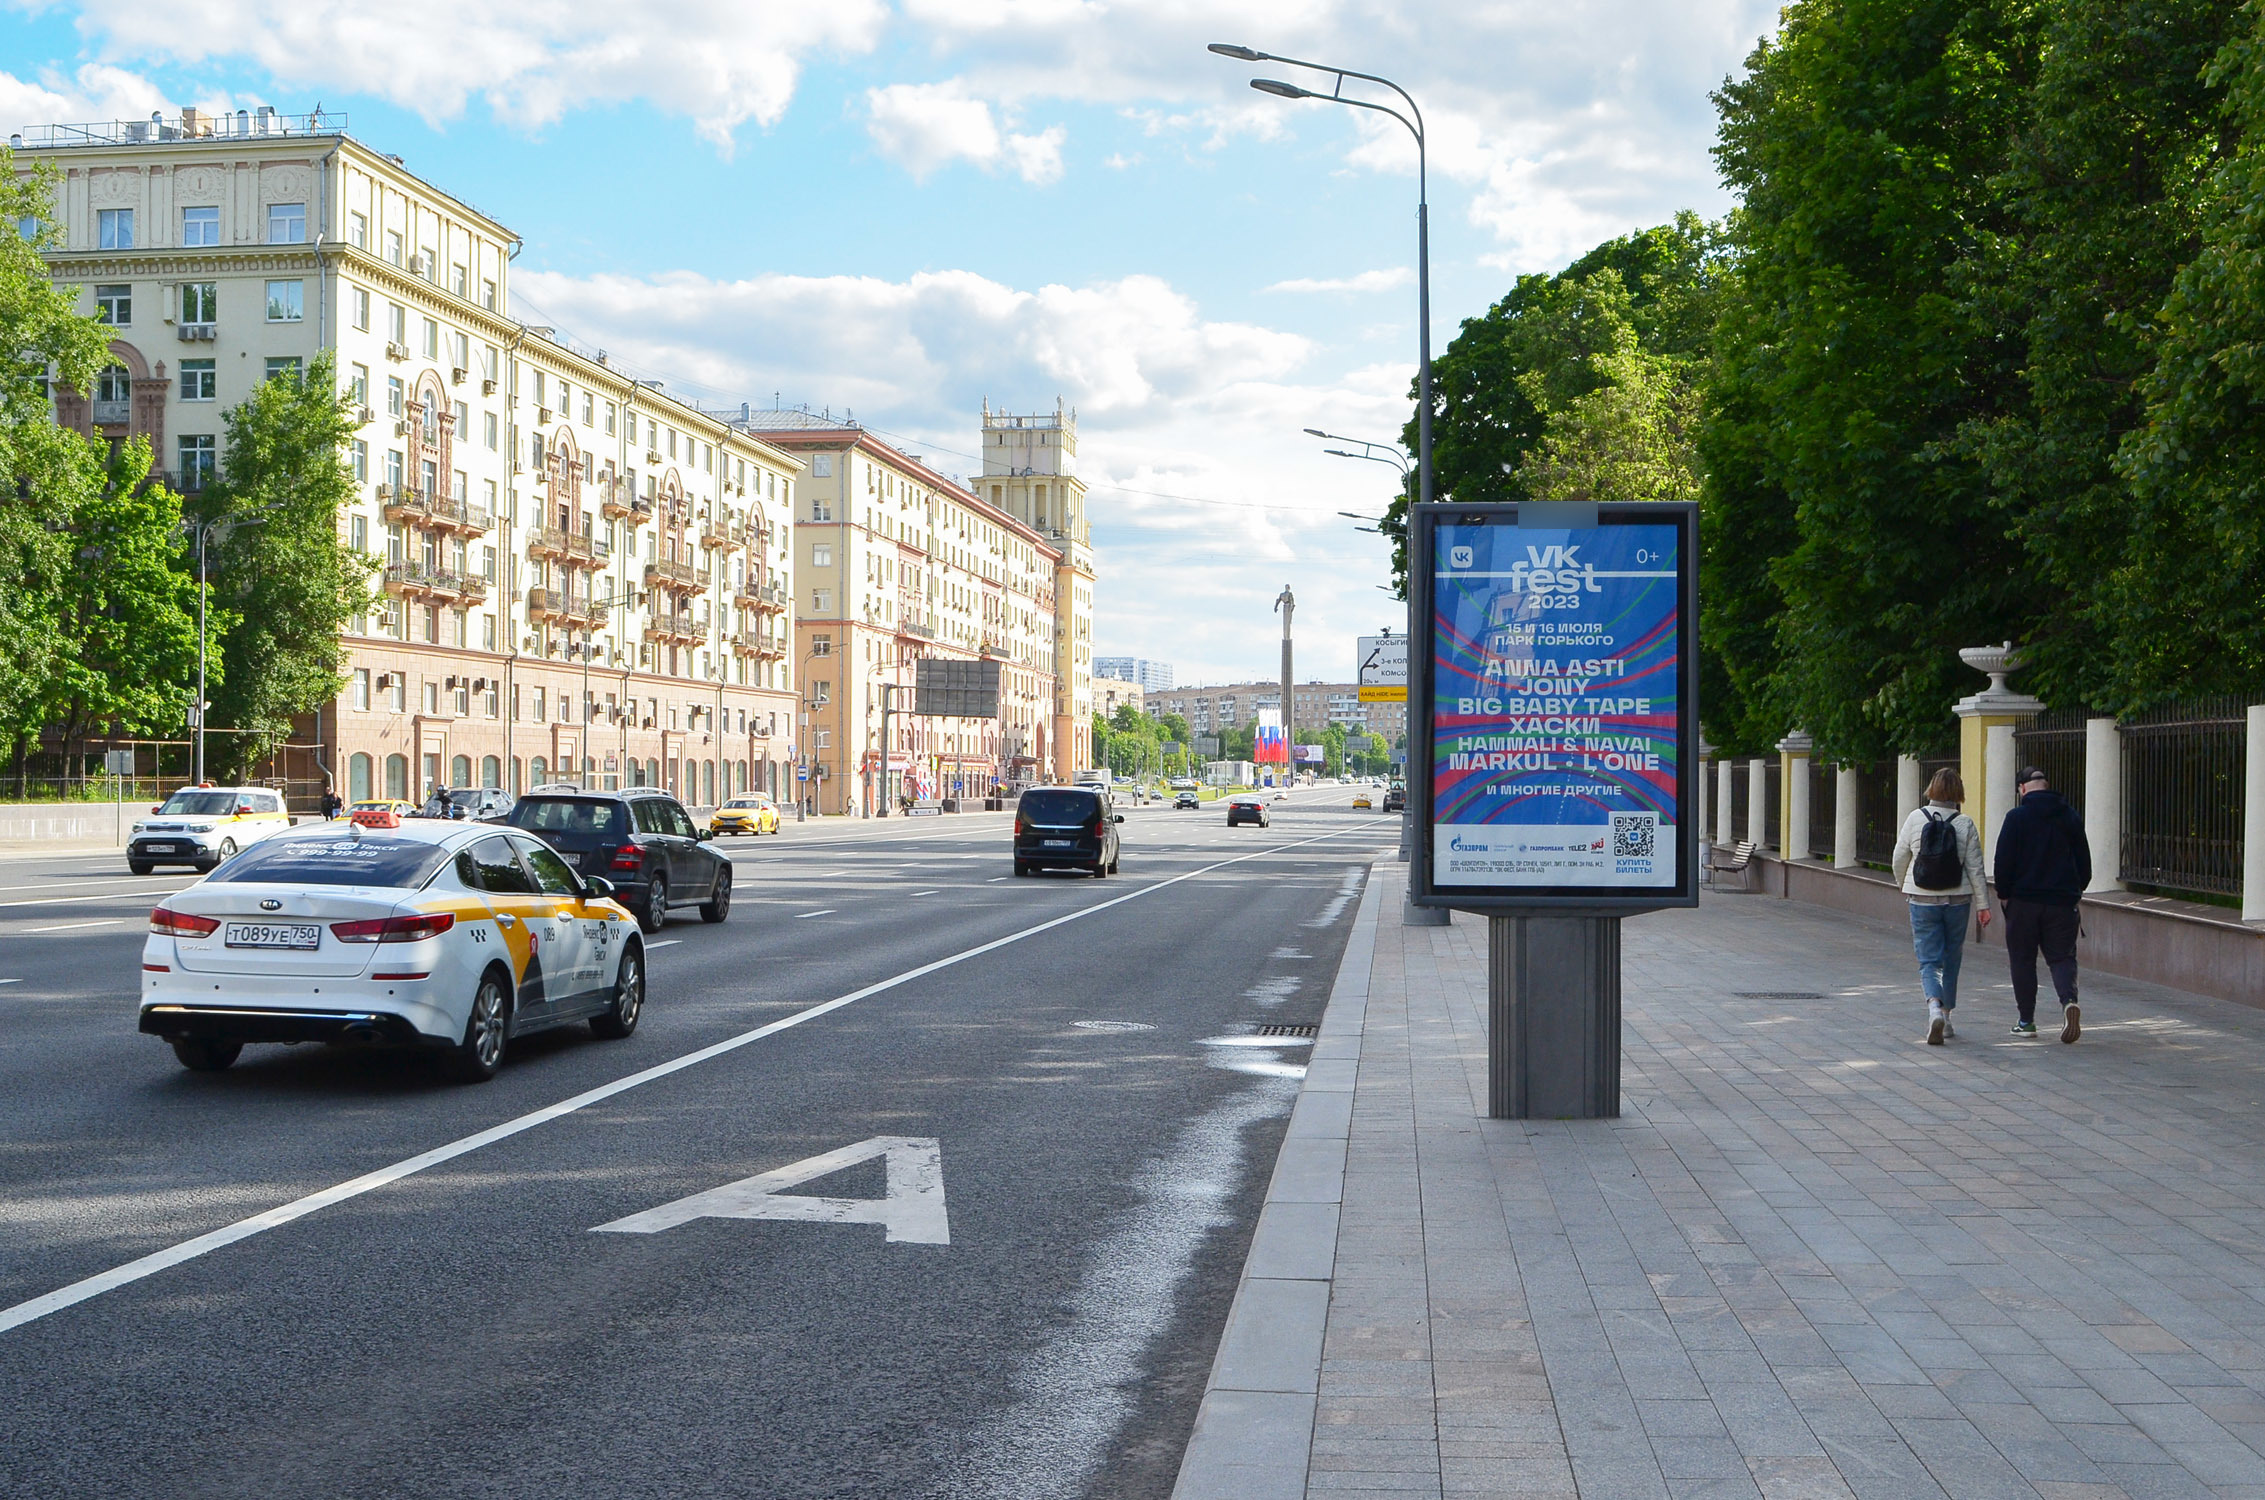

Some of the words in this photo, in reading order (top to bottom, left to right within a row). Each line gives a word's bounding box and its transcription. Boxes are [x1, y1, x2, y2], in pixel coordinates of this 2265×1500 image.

[1526, 545, 1581, 568] VK
[1636, 548, 1660, 564] 0+
[1511, 560, 1602, 593] fest
[1528, 595, 1580, 609] 2023
[1506, 623, 1521, 633] 15
[1525, 623, 1537, 633] И
[1540, 623, 1554, 633] 16
[1558, 623, 1603, 633] ИЮЛЯ
[1495, 635, 1535, 646] ПАРК
[1537, 635, 1614, 646] ГОРЬКОГО
[1485, 659, 1563, 677] ANNA
[1566, 659, 1624, 677] ASTI
[1518, 679, 1590, 696] JONY
[1458, 698, 1502, 715] BIG
[1509, 698, 1581, 715] BABY
[1583, 698, 1651, 715] TAPE
[1509, 717, 1600, 734] ХАСКИ
[1457, 737, 1557, 751] HAMMALI
[1562, 736, 1580, 752] &
[1585, 737, 1650, 751] NAVAI
[1449, 753, 1557, 771] MARKUL
[1583, 753, 1659, 771] L'ONE
[1487, 785, 1497, 795] И
[1500, 785, 1561, 795] МНОГИЕ
[1563, 785, 1622, 797] ДРУГИЕ
[297, 849, 378, 857] 999-99-99
[232, 926, 289, 943] Т089УЕ
[292, 927, 315, 939] 750
[543, 927, 556, 942] 089
